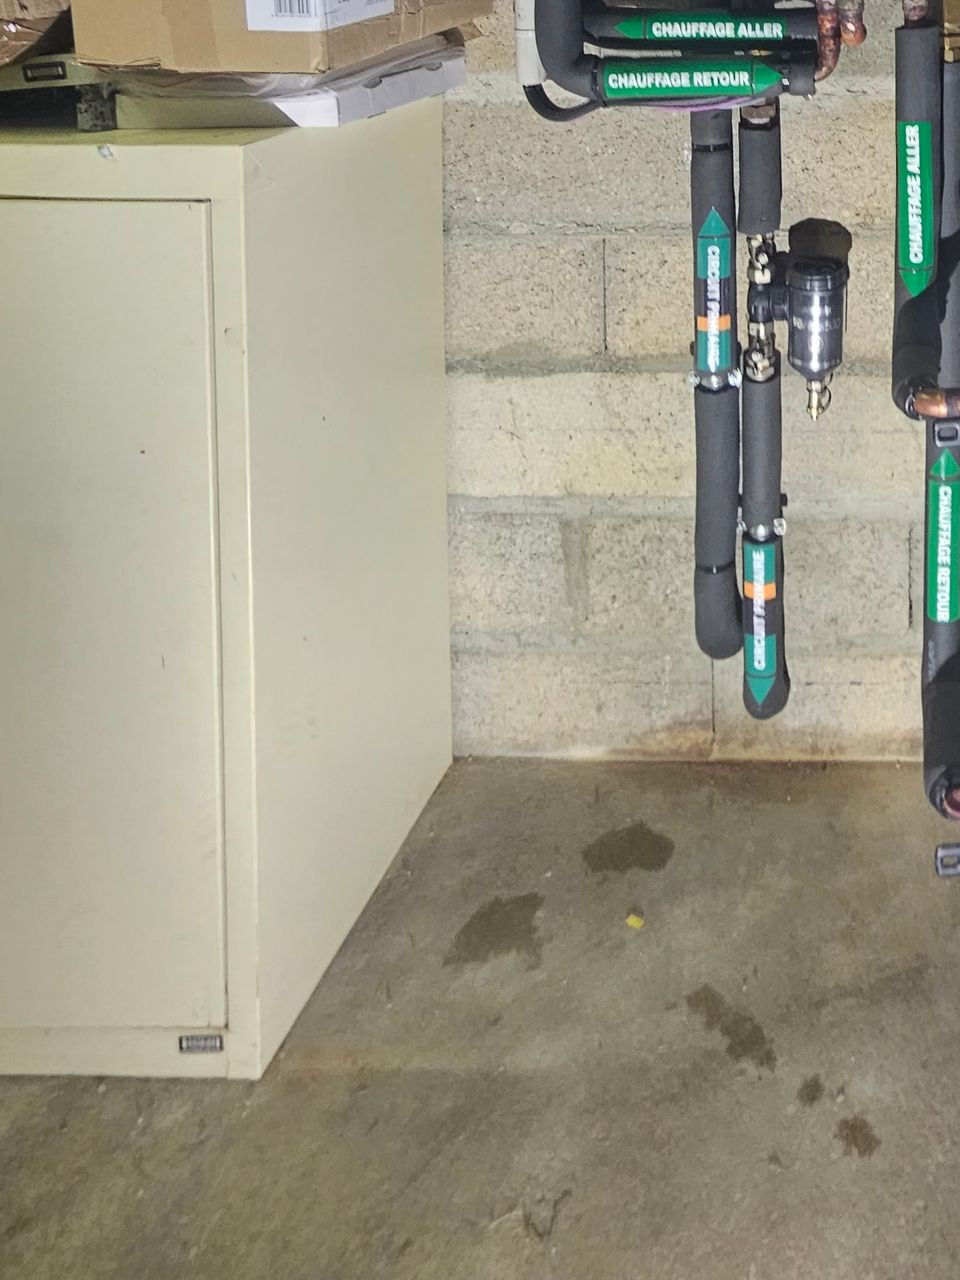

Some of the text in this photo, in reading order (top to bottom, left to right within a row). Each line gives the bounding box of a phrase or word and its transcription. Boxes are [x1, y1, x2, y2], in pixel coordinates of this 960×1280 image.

[652, 22, 784, 39] CHAUFFAGE ALLER
[608, 70, 750, 89] CHAUFFAGE RETOUR
[905, 124, 924, 264] CHAUFFAGE ALLER
[706, 245, 720, 301] CIRCUIT
[936, 485, 952, 623] CHAUFFAGE RETOUR
[753, 615, 766, 671] CIRCUIT
